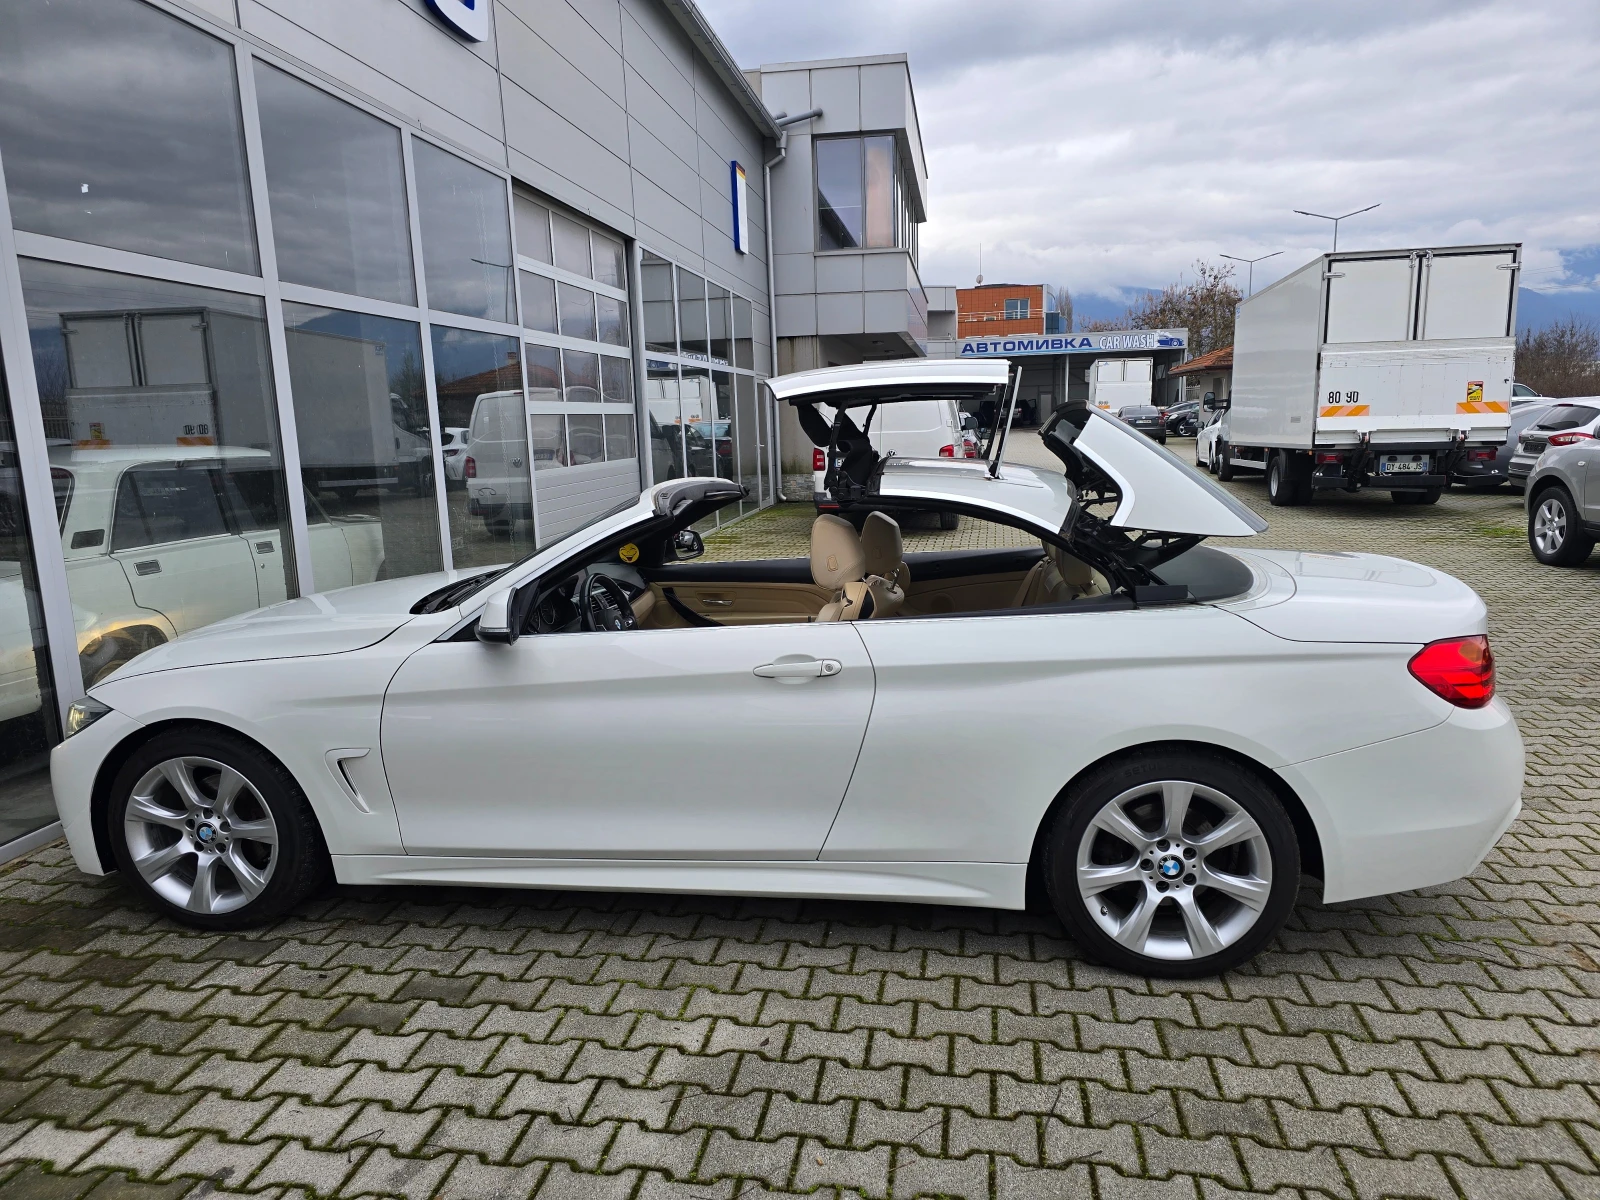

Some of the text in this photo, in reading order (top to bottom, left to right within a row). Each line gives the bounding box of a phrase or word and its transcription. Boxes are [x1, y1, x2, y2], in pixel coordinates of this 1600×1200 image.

[961, 337, 1093, 354] АВТОМИВКА
[1099, 333, 1155, 350] CAR WASH
[1328, 391, 1341, 404] 80
